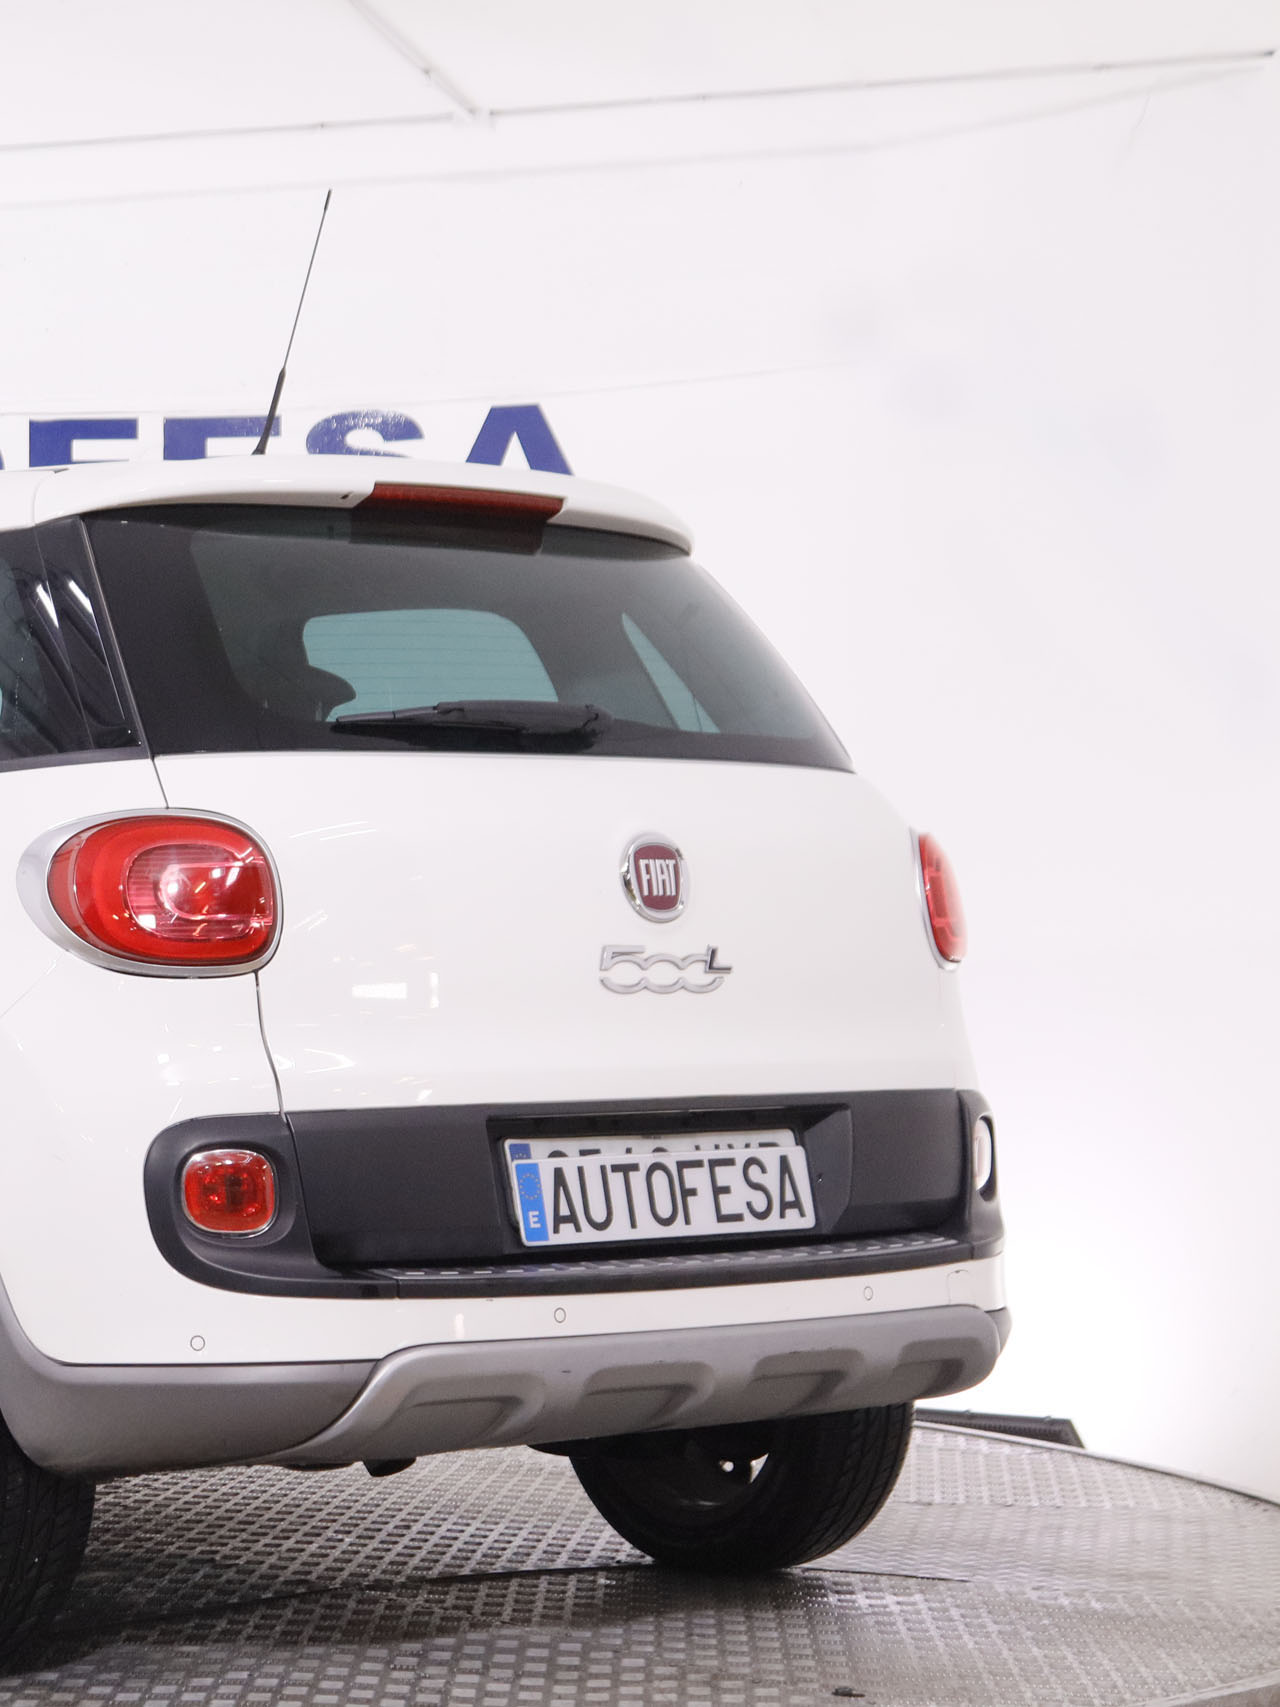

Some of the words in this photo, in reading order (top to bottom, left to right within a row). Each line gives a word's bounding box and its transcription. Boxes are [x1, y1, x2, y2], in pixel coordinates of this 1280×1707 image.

[639, 858, 677, 897] FIAT
[599, 943, 733, 995] 500L
[552, 1154, 807, 1235] AUTOFESA
[528, 1210, 542, 1229] E
